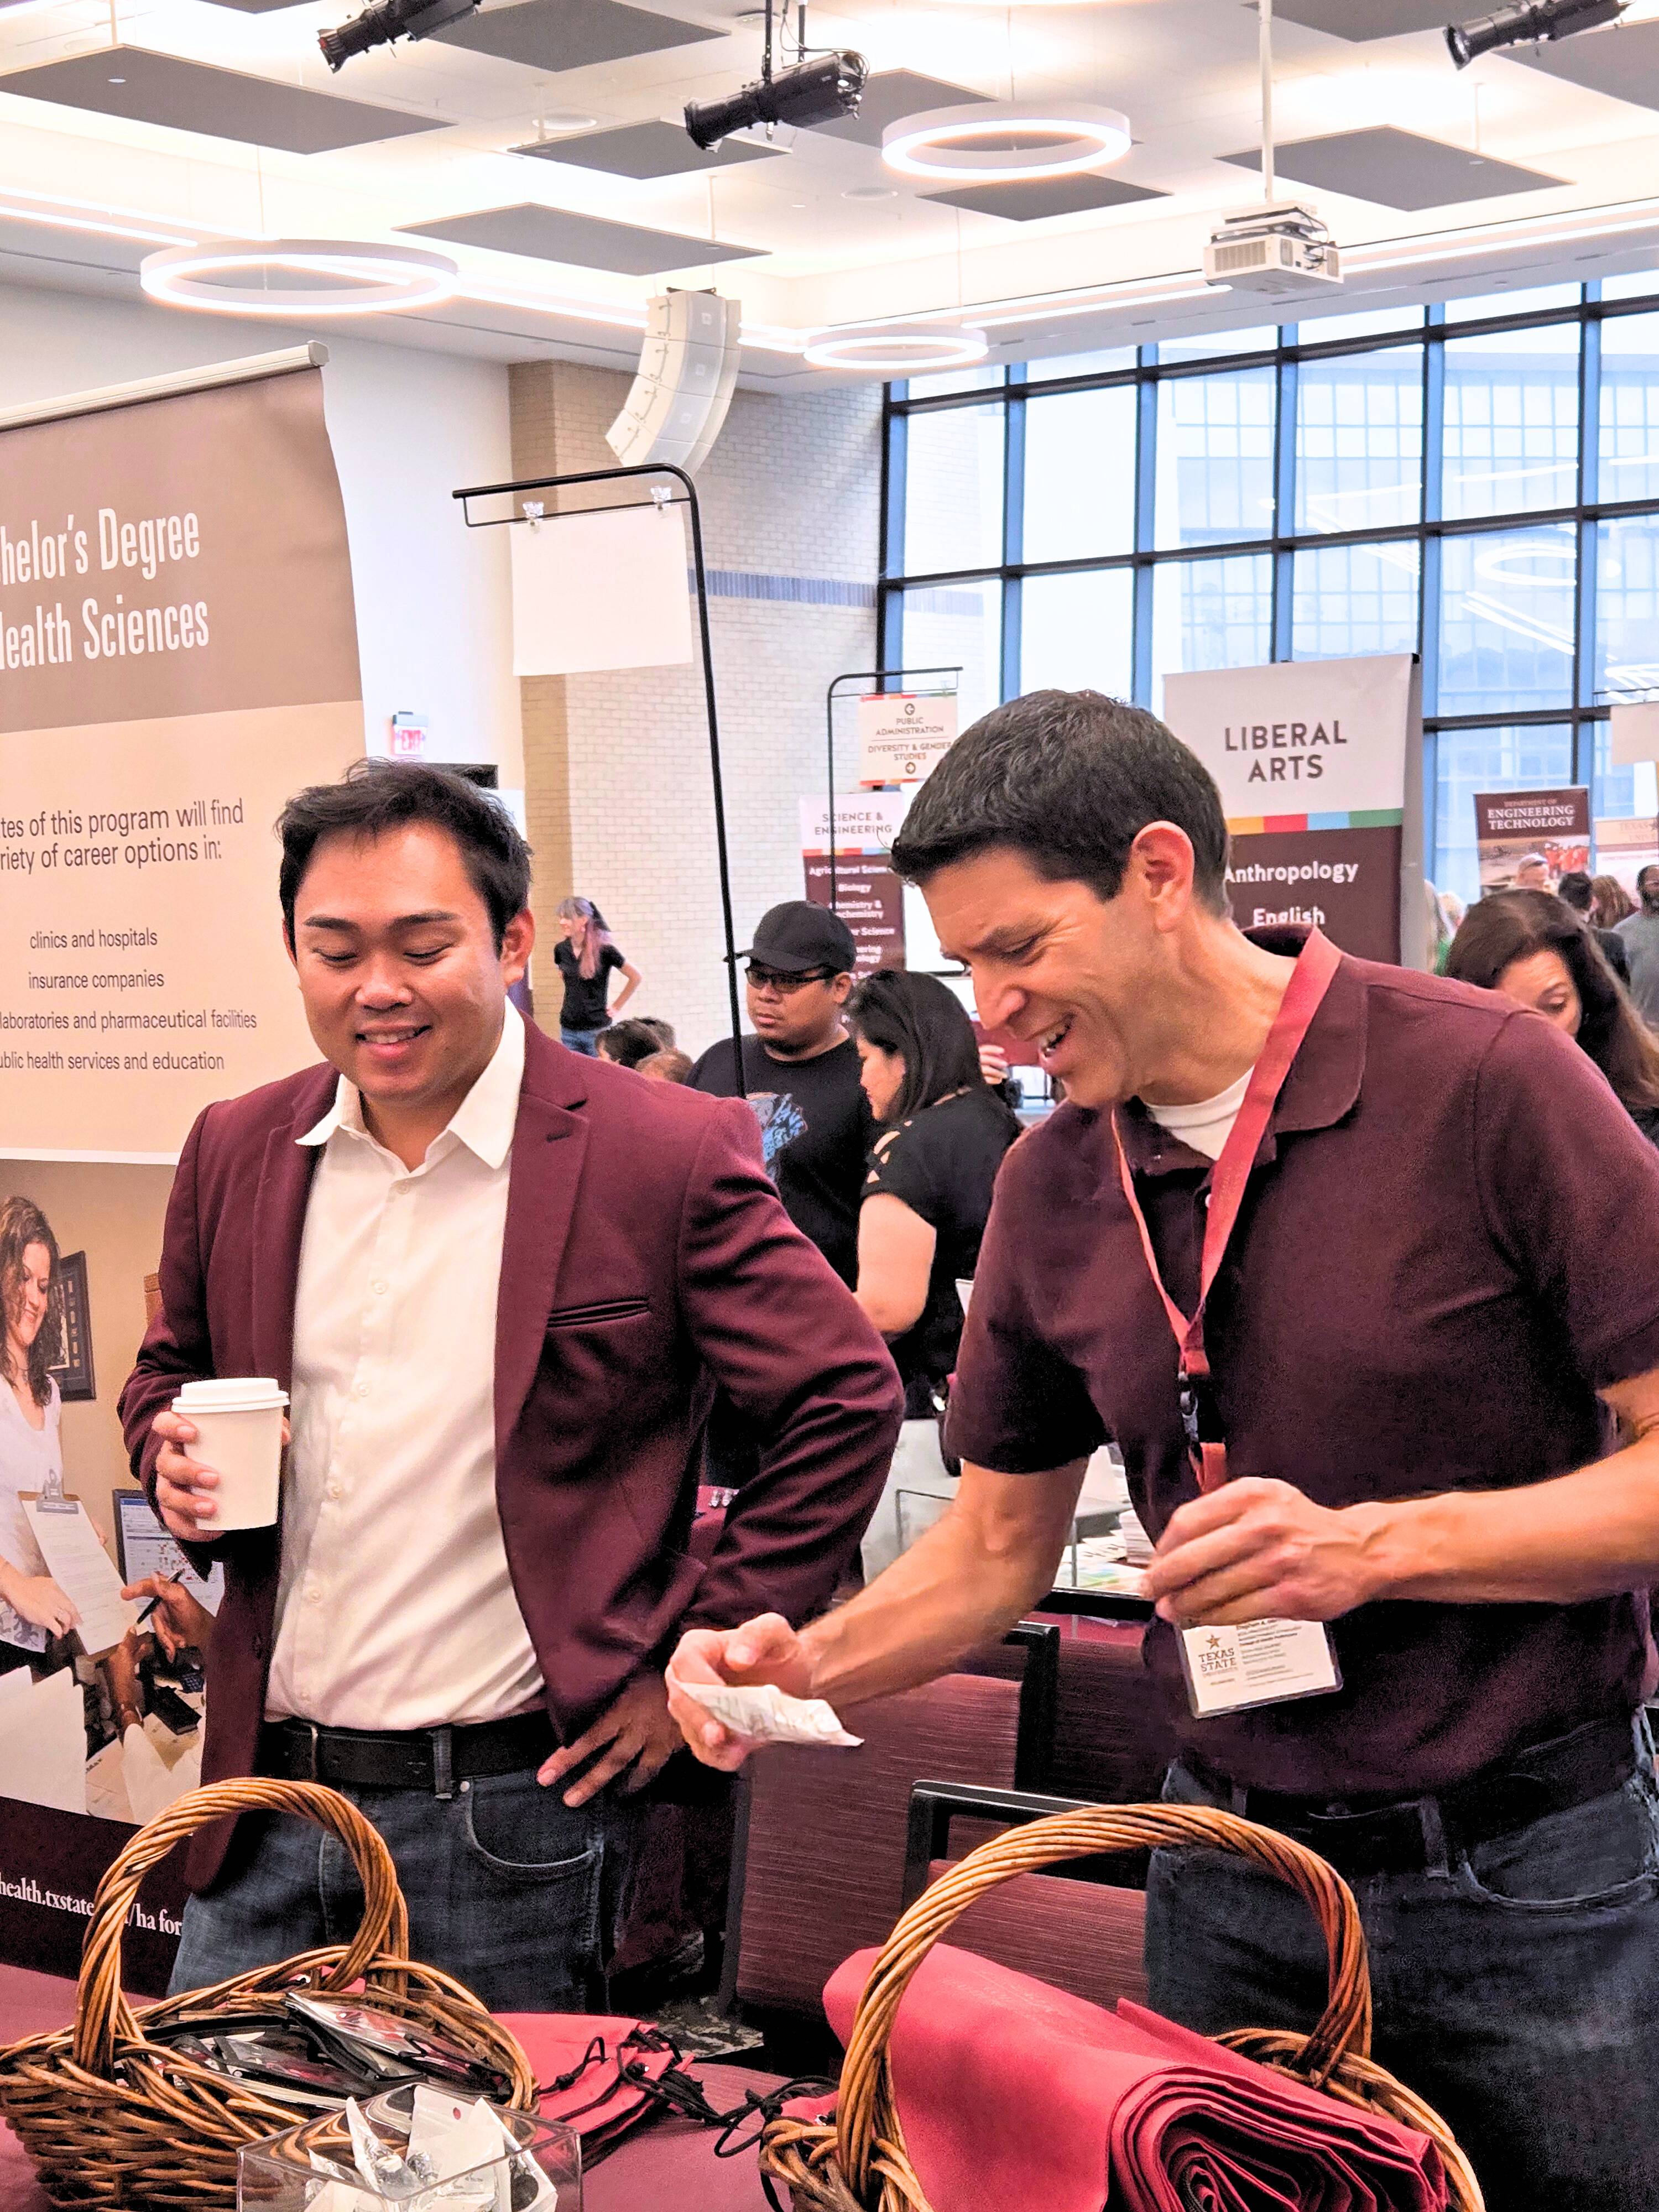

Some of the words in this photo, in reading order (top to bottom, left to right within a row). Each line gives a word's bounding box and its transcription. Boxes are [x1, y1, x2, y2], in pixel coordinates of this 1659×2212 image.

[98, 508, 200, 580] Degree
[82, 594, 209, 660] Sciences
[876, 726, 944, 735] ADMINISTRATION
[1225, 721, 1347, 751] LIBERAL
[868, 744, 910, 753] DIVERSITY
[1248, 754, 1323, 782] ARTS
[1, 817, 24, 838] tes
[29, 811, 46, 836] of
[51, 810, 82, 834] this
[89, 808, 169, 838] program
[176, 800, 207, 827] will
[211, 798, 244, 825] find
[822, 812, 872, 822] SIENCE
[876, 812, 883, 821] &
[1488, 805, 1575, 818] ENGINEERING
[815, 825, 892, 836] ENINEERING
[1489, 817, 1574, 830] TECHNOLOGY
[41, 842, 58, 868] of
[64, 845, 118, 867] career
[125, 837, 198, 868] options
[204, 834, 222, 860] in:
[1224, 861, 1358, 885] Anthropology
[1253, 906, 1326, 927] English
[30, 930, 67, 949] clinics
[71, 929, 95, 948] and
[99, 927, 158, 951] hospitals
[28, 972, 88, 989] insurance
[92, 969, 165, 992] companies
[0, 1011, 69, 1029] laboratories
[74, 1011, 96, 1029] and
[101, 1010, 207, 1032] pharmaceutical
[211, 1009, 257, 1029] facilities
[27, 1051, 64, 1070] health
[67, 1052, 120, 1070] services
[124, 1051, 148, 1070] and
[153, 1051, 225, 1070] education
[1198, 1648, 1234, 1662] TEXAS
[1200, 1658, 1237, 1672] STATE
[159, 1909, 183, 1936] for
